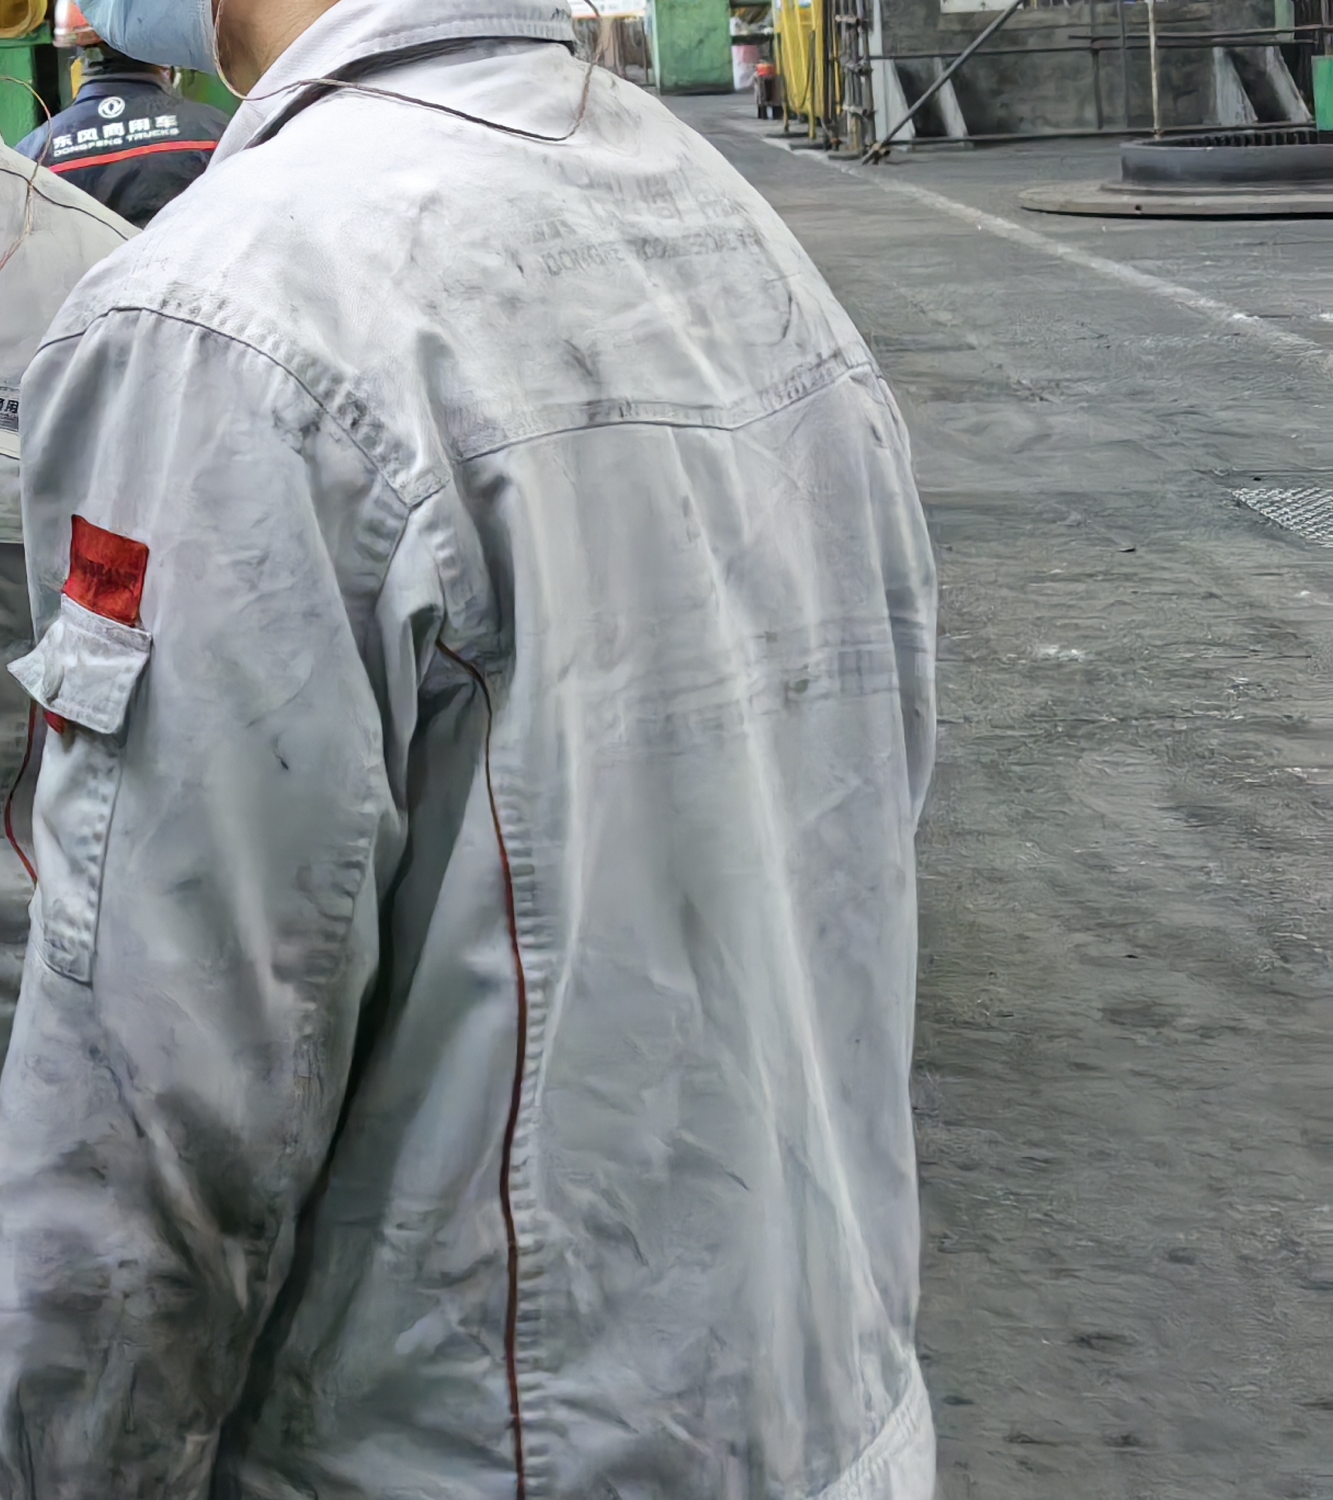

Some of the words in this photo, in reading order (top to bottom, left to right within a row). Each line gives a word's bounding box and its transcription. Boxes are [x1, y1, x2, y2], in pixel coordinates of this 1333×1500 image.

[52, 114, 178, 149] 东风商用车
[53, 137, 124, 158] DONGFENG
[126, 127, 180, 143] TRUCKS
